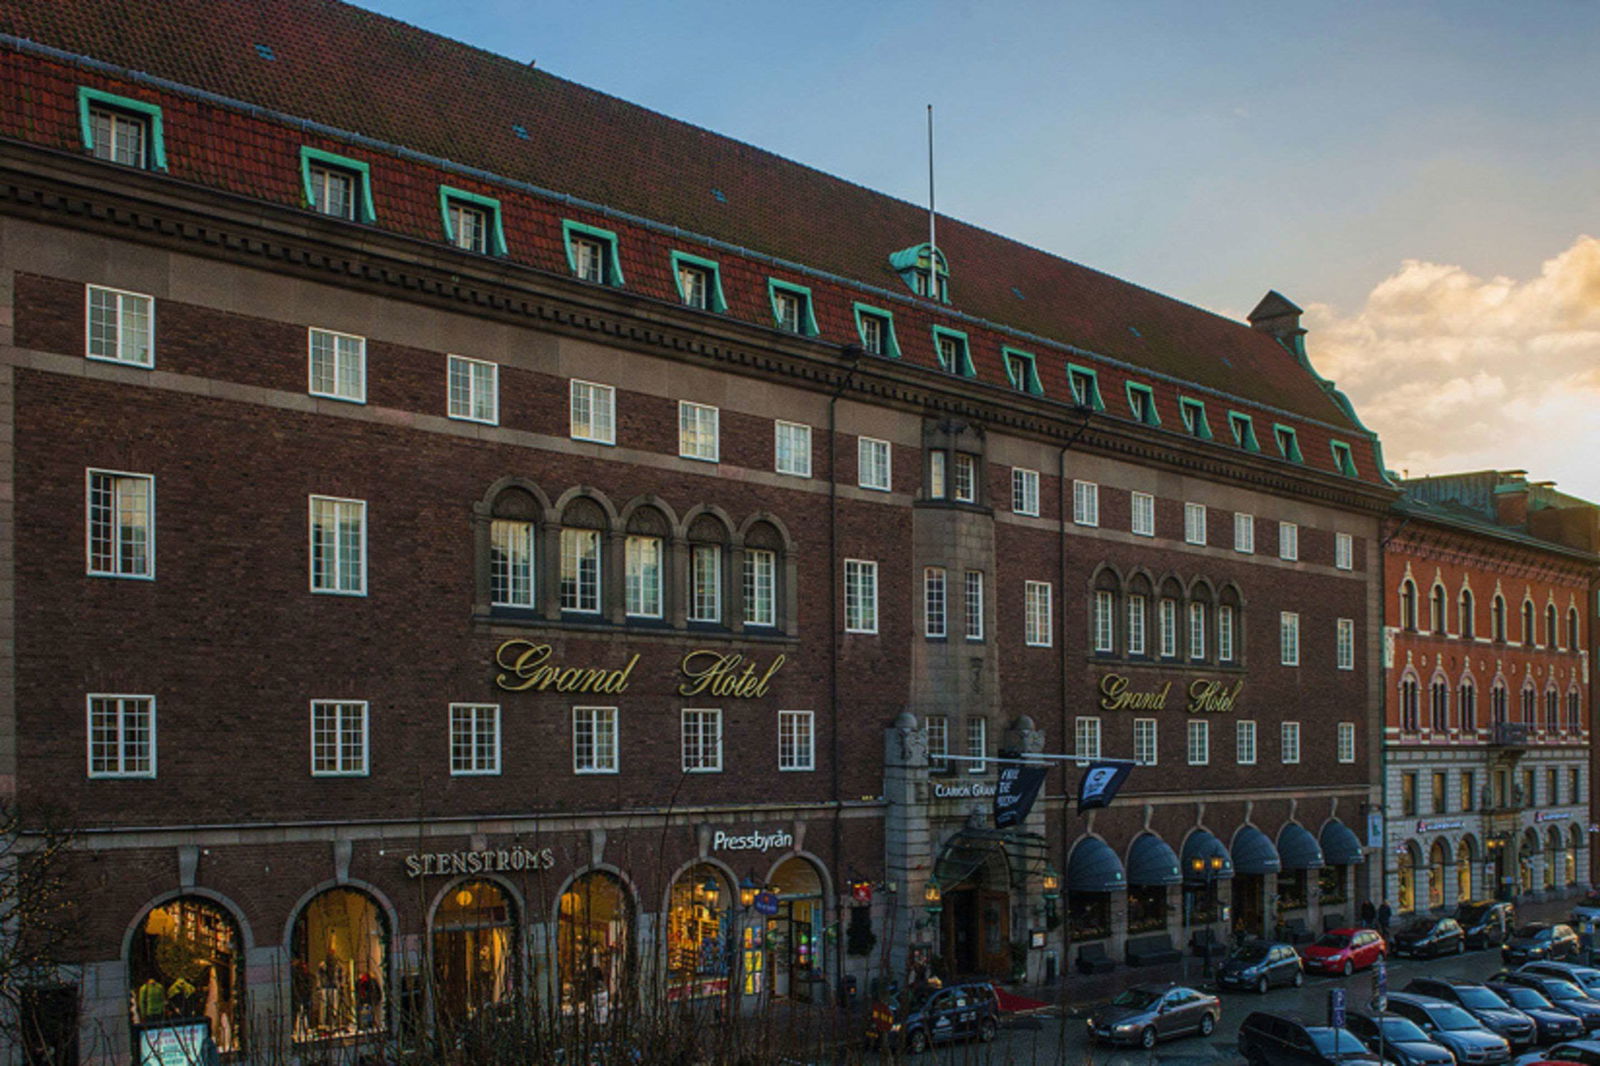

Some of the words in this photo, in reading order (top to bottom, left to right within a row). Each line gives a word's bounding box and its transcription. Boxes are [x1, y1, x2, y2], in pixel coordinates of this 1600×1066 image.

[496, 639, 640, 694] Grand
[679, 650, 786, 698] Hotel
[1100, 672, 1172, 710] Grand
[1187, 678, 1243, 713] Hotel
[713, 830, 793, 853] Pressbyrån
[405, 845, 555, 878] STENSTRÖMS
